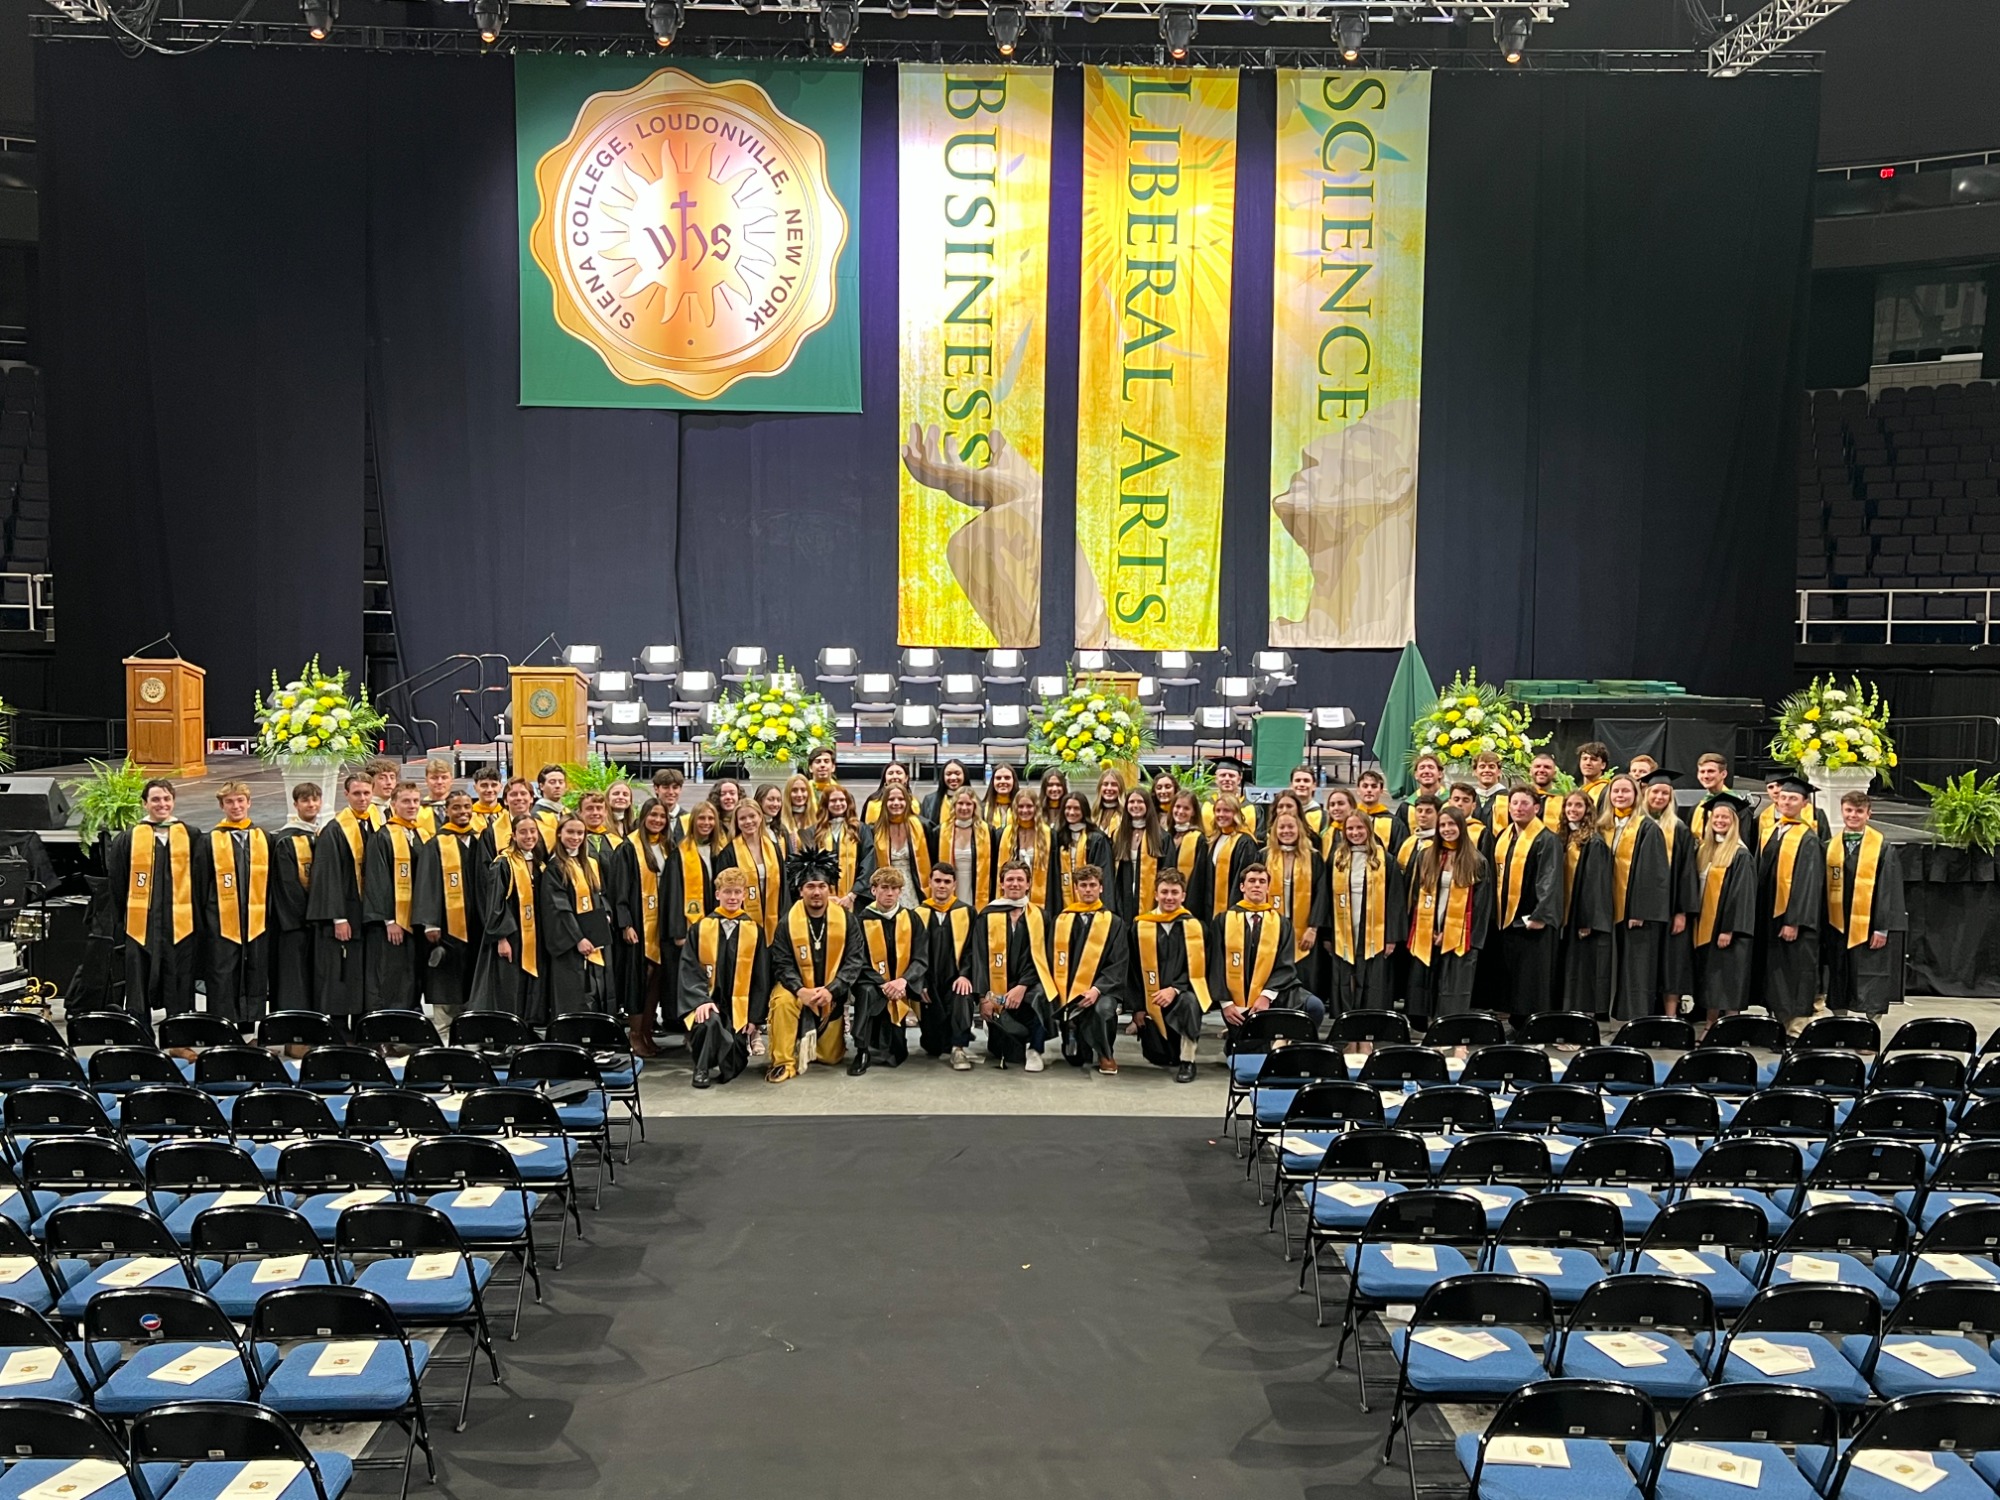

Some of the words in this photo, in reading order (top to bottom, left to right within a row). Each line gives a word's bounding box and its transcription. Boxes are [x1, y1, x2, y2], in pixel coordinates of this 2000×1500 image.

[636, 113, 790, 196] LOUDONVILLE,
[572, 136, 634, 247] COLLEGE,
[784, 208, 803, 266] NEW
[1119, 75, 1194, 403] LIBERAL
[1316, 76, 1387, 423] SCIENCE
[944, 72, 1007, 464] BUSINESS
[579, 256, 635, 330] SIENA
[745, 275, 797, 332] YORK
[1115, 422, 1182, 628] ARTS
[400, 863, 408, 877] S
[1832, 866, 1840, 880] S
[137, 872, 148, 887] S
[224, 873, 232, 888] S
[450, 872, 458, 887] S
[1064, 873, 1070, 886] S
[749, 886, 756, 900] S
[582, 896, 589, 911] S
[648, 896, 656, 910] S
[1273, 895, 1281, 909] S
[1339, 894, 1345, 908] S
[1424, 894, 1433, 909] S
[525, 905, 532, 920] S
[800, 945, 808, 960] S
[1059, 951, 1066, 966] S
[1232, 952, 1241, 967] S
[879, 961, 886, 975] S
[995, 954, 1003, 968] S
[706, 964, 713, 978] S
[1149, 971, 1156, 985] S
